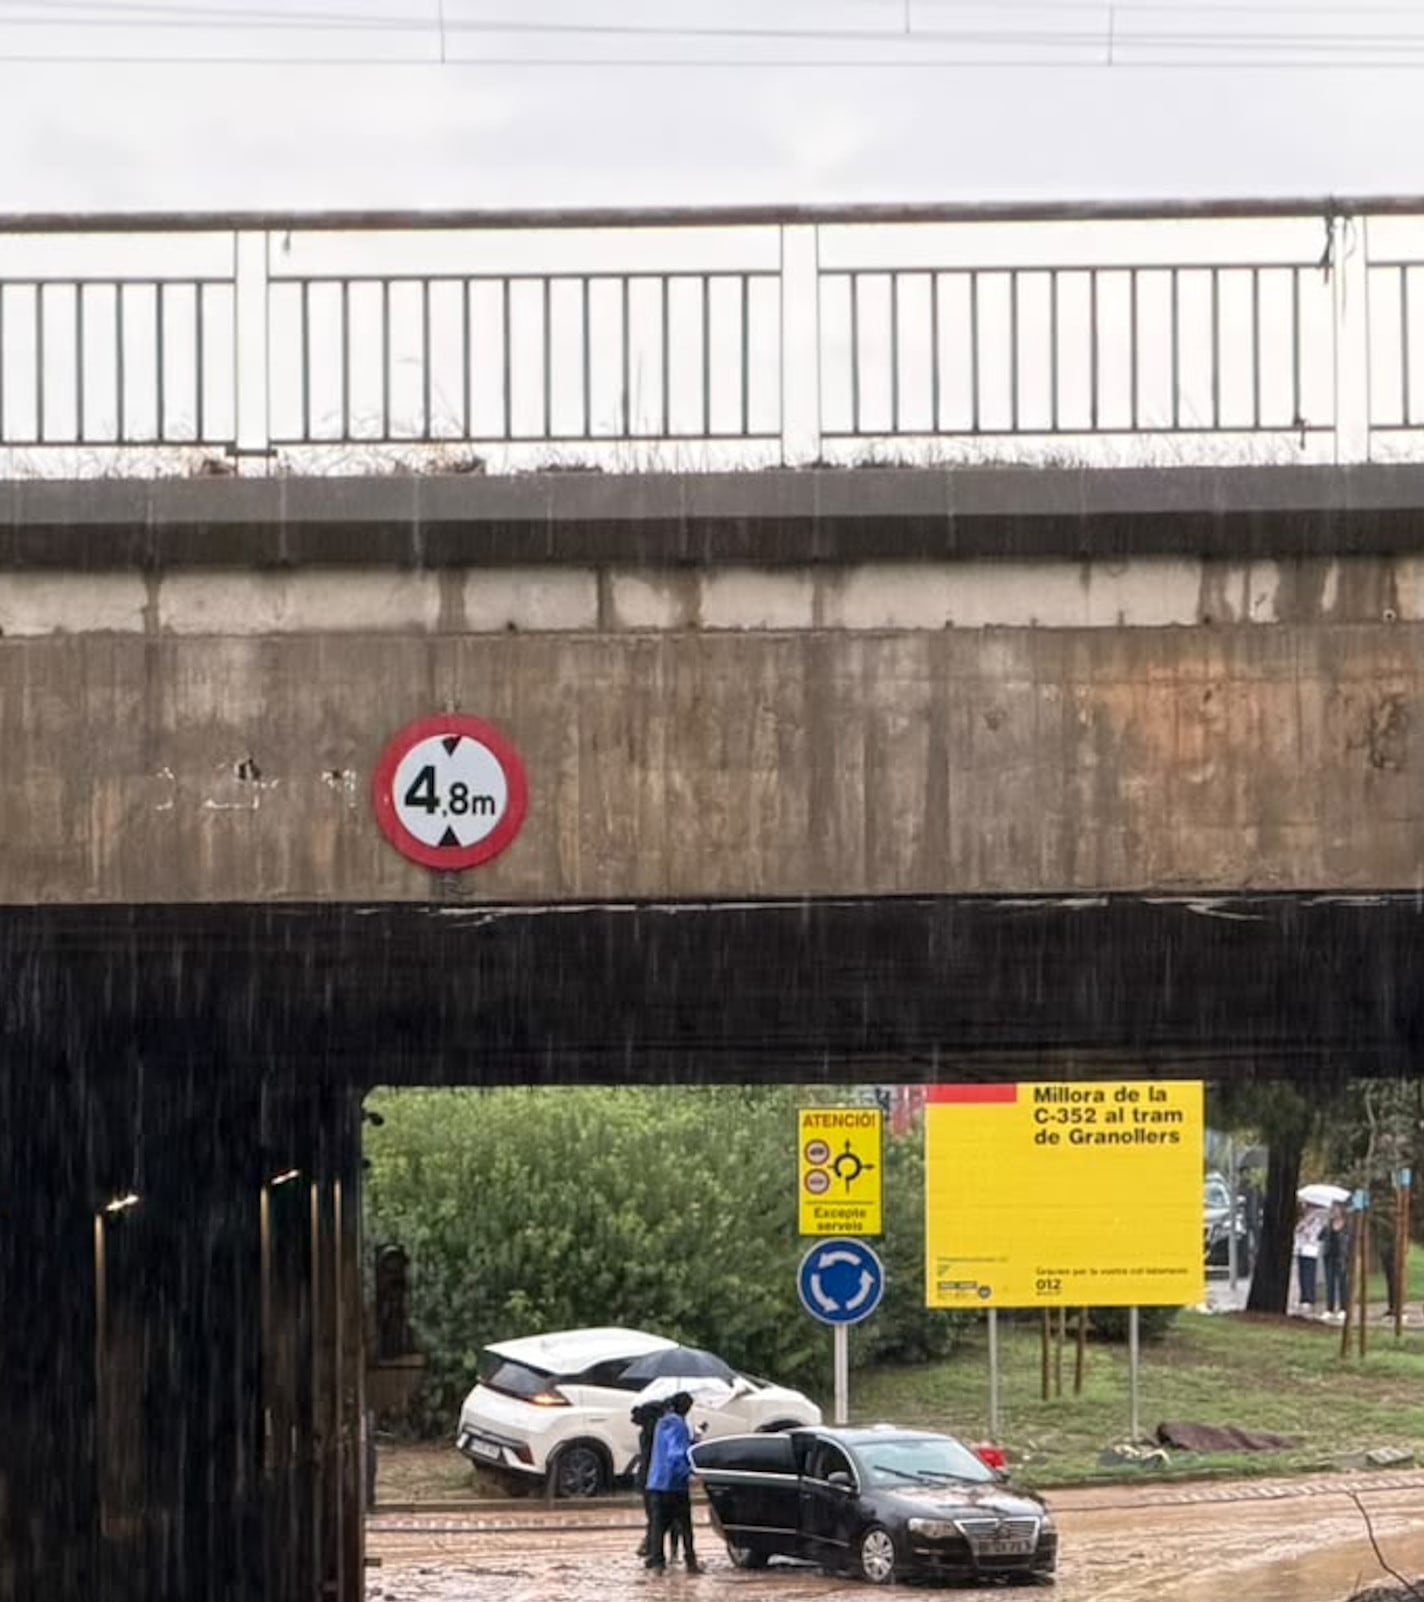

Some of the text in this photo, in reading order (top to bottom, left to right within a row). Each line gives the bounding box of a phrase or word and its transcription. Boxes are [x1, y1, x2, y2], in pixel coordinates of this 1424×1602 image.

[405, 765, 496, 817] 4,8m
[1034, 1086, 1167, 1103] Millora de la
[1034, 1107, 1183, 1123] C-352 al tram
[1034, 1128, 1181, 1145] de Granollers
[814, 1207, 866, 1220] Excepte
[1036, 1279, 1062, 1290] 012
